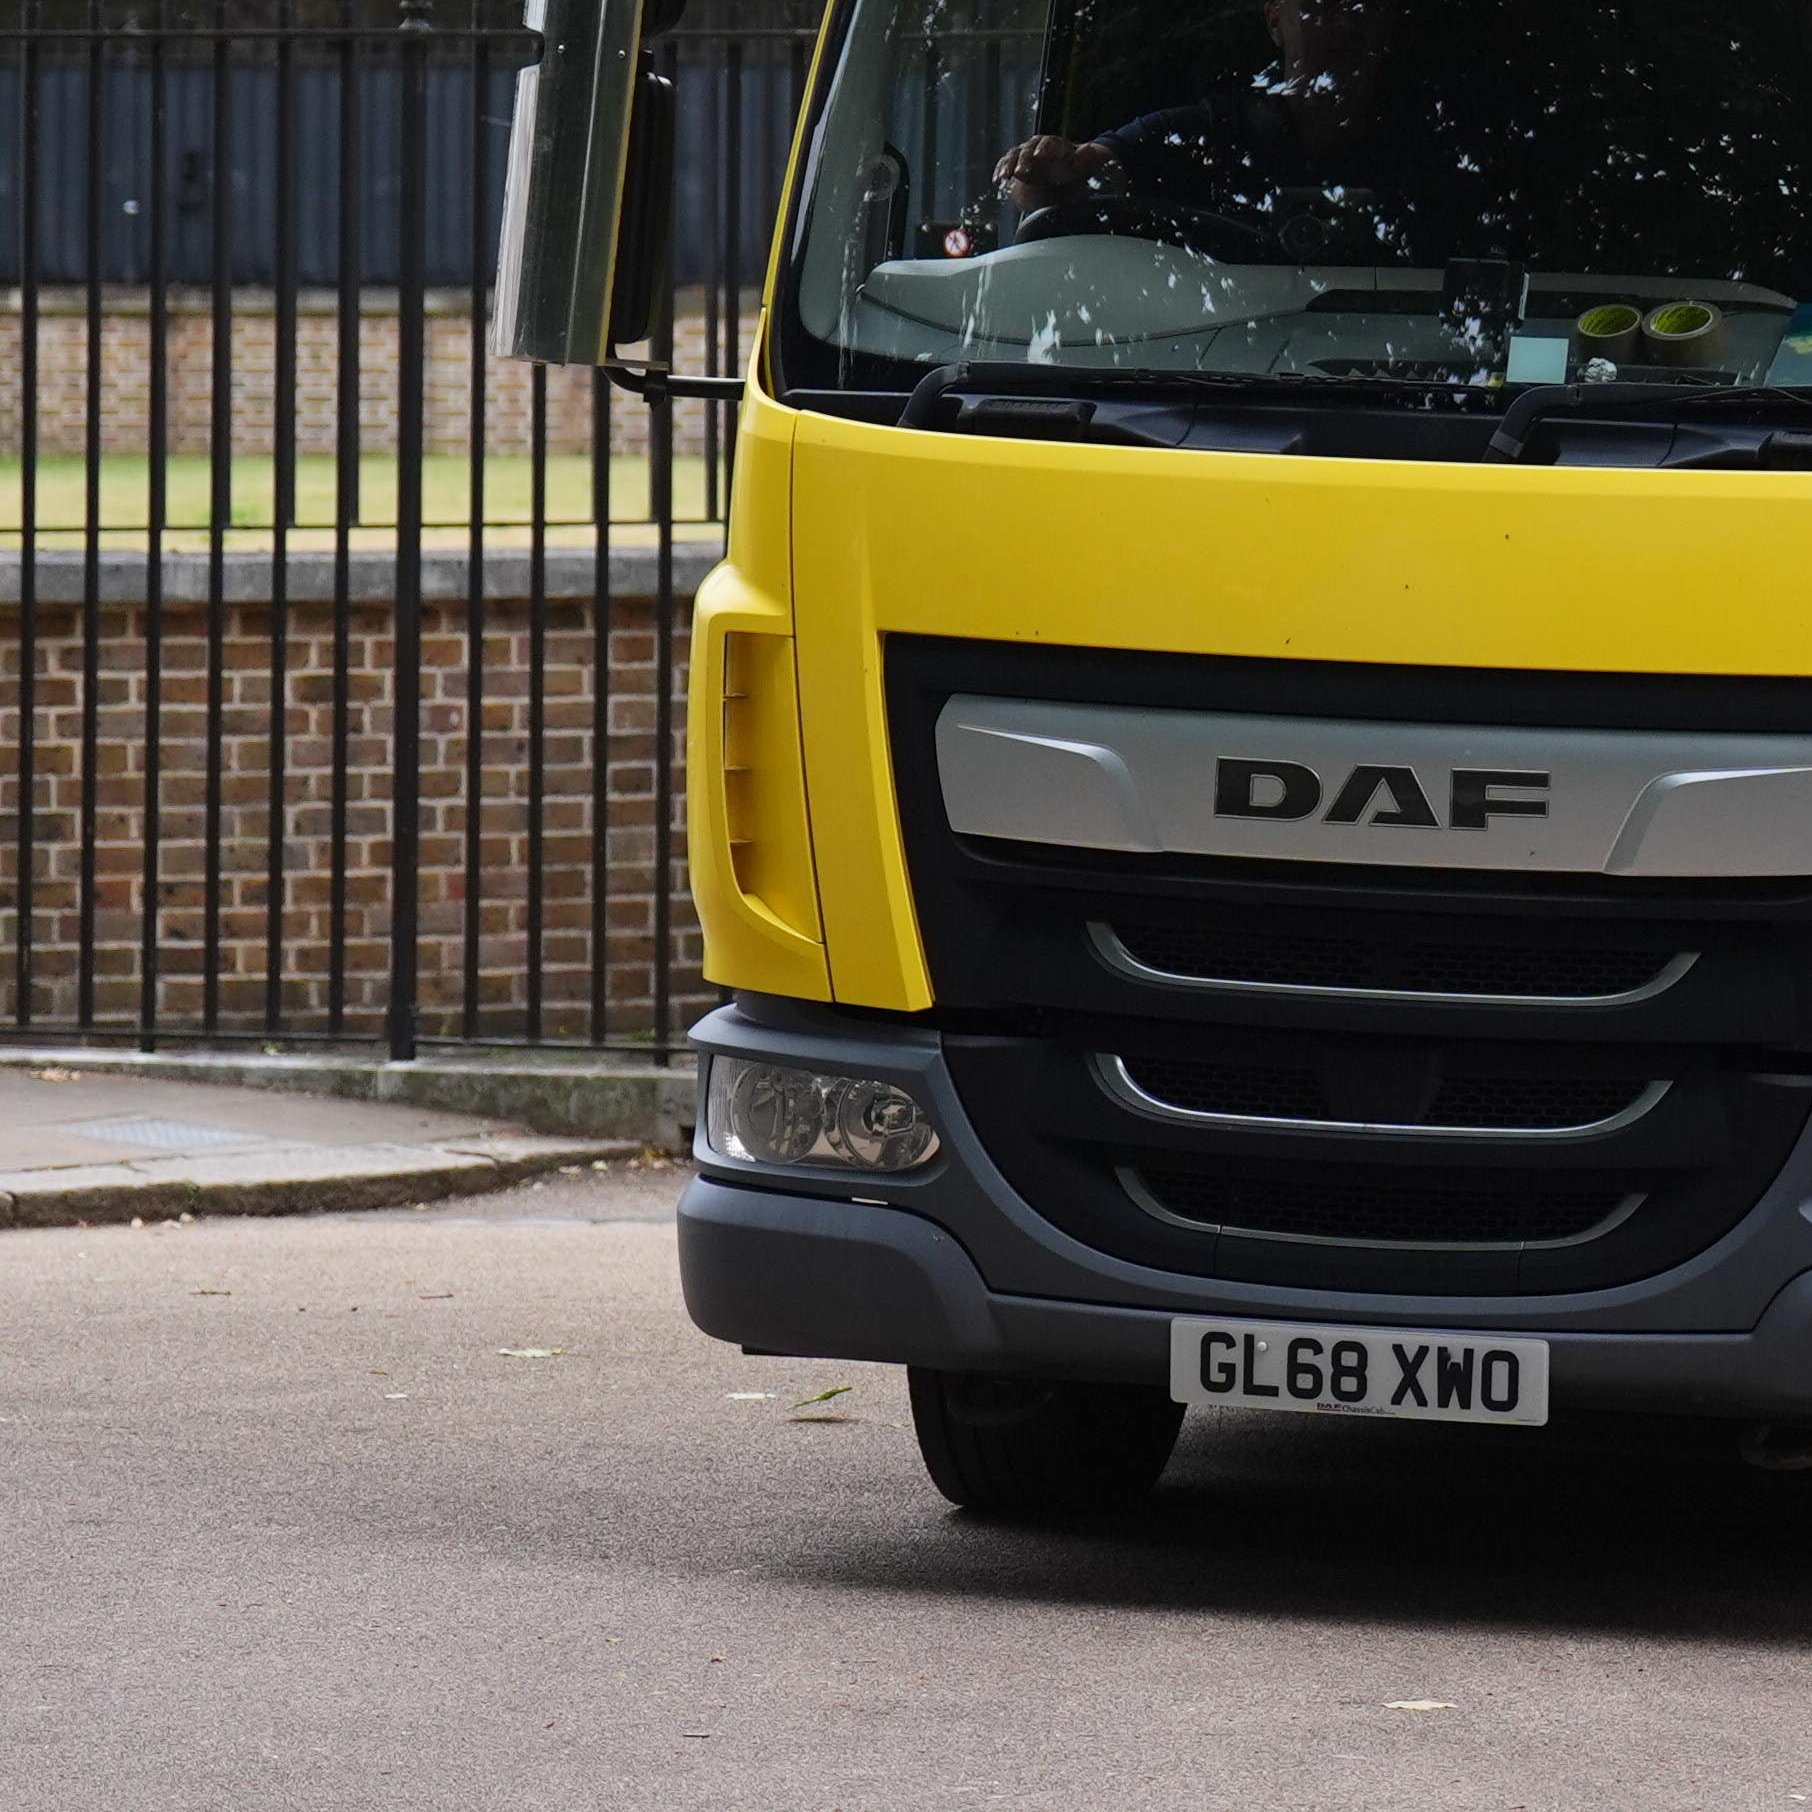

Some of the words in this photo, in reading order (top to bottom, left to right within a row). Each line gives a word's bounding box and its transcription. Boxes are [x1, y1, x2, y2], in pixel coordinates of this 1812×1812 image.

[1215, 755, 1551, 831] DAF
[1199, 1330, 1369, 1403] GL68
[1391, 1344, 1519, 1413] XWO
